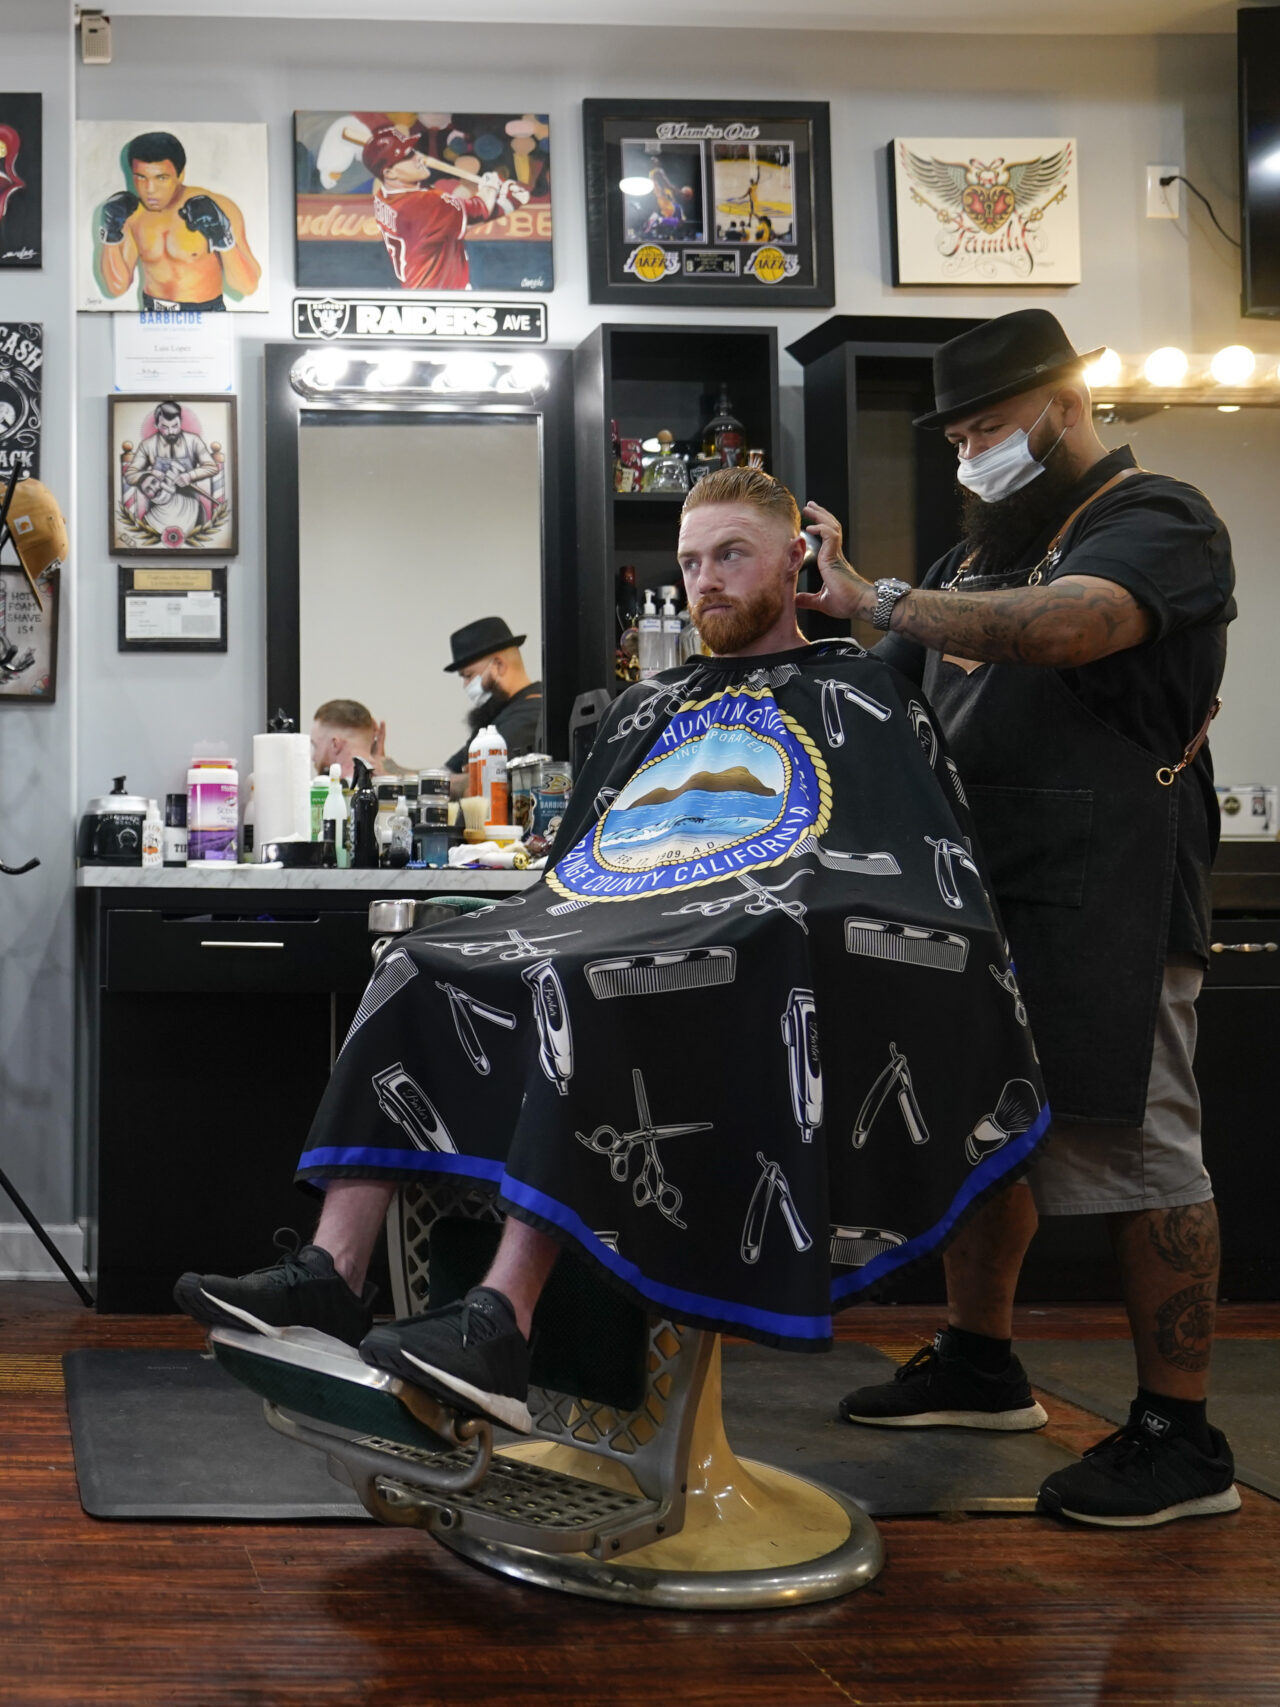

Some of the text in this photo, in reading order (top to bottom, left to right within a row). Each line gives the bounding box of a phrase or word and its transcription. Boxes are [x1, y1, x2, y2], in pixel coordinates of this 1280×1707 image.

[658, 123, 760, 140] Mamba Out
[627, 253, 675, 270] LAKERS
[746, 255, 795, 272] LAKERS
[140, 312, 203, 325] BARBICIDE
[356, 305, 531, 335] RAIDERS AVE
[8, 603, 37, 612] FOAM
[7, 614, 42, 623] SHAVE
[582, 870, 666, 893] COUNTY
[673, 805, 813, 882] CALIFORNIA
